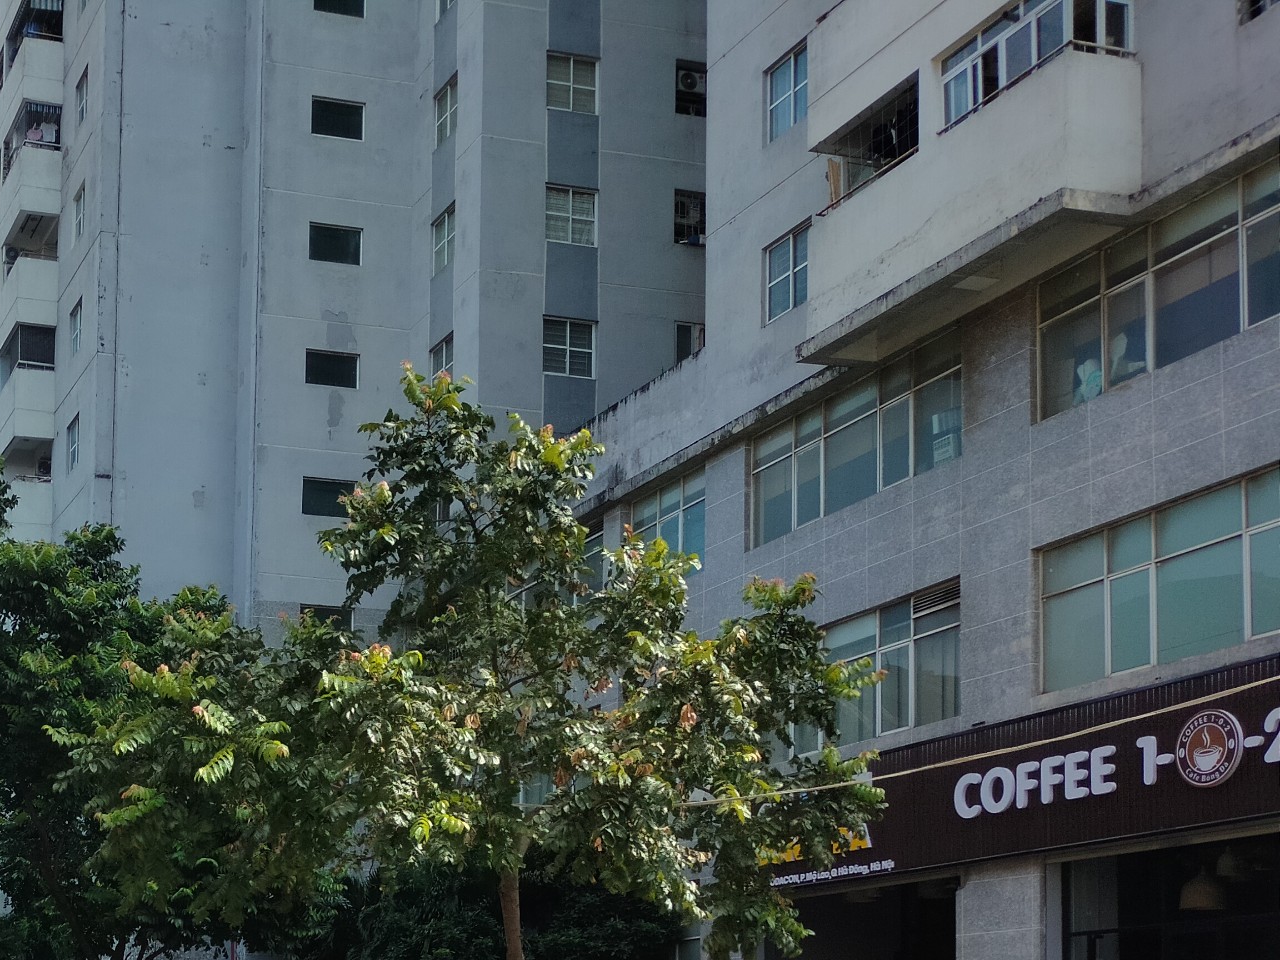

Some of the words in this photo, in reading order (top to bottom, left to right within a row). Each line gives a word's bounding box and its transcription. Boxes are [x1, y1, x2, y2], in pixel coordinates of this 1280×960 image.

[1182, 716, 1208, 742] COFFEE
[954, 745, 1117, 819] COFFEE
[1185, 768, 1200, 781] Cafe
[870, 861, 881, 871] Hà
[882, 859, 895, 871] Nội
